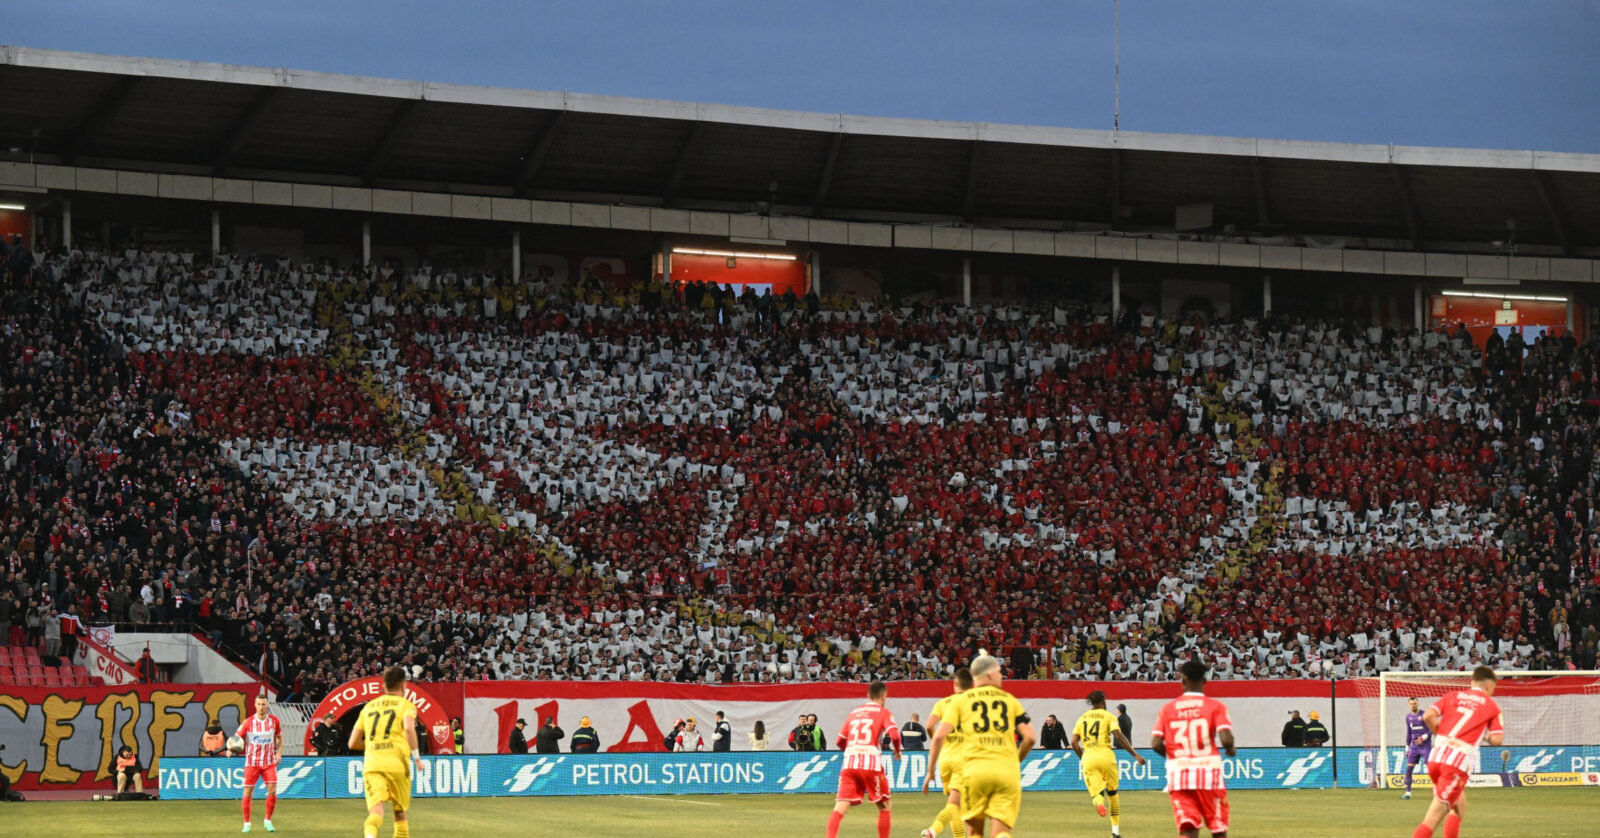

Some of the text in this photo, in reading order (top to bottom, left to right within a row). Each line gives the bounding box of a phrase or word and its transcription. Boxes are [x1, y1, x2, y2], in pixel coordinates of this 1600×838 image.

[361, 682, 380, 696] JE
[368, 709, 396, 741] 77
[848, 718, 874, 745] 33
[971, 700, 1010, 733] 33
[1082, 720, 1100, 742] 14
[1448, 706, 1474, 738] 7
[1170, 718, 1213, 757] 30
[348, 758, 478, 795] GROM
[573, 763, 764, 785] PETROL STATIONS
